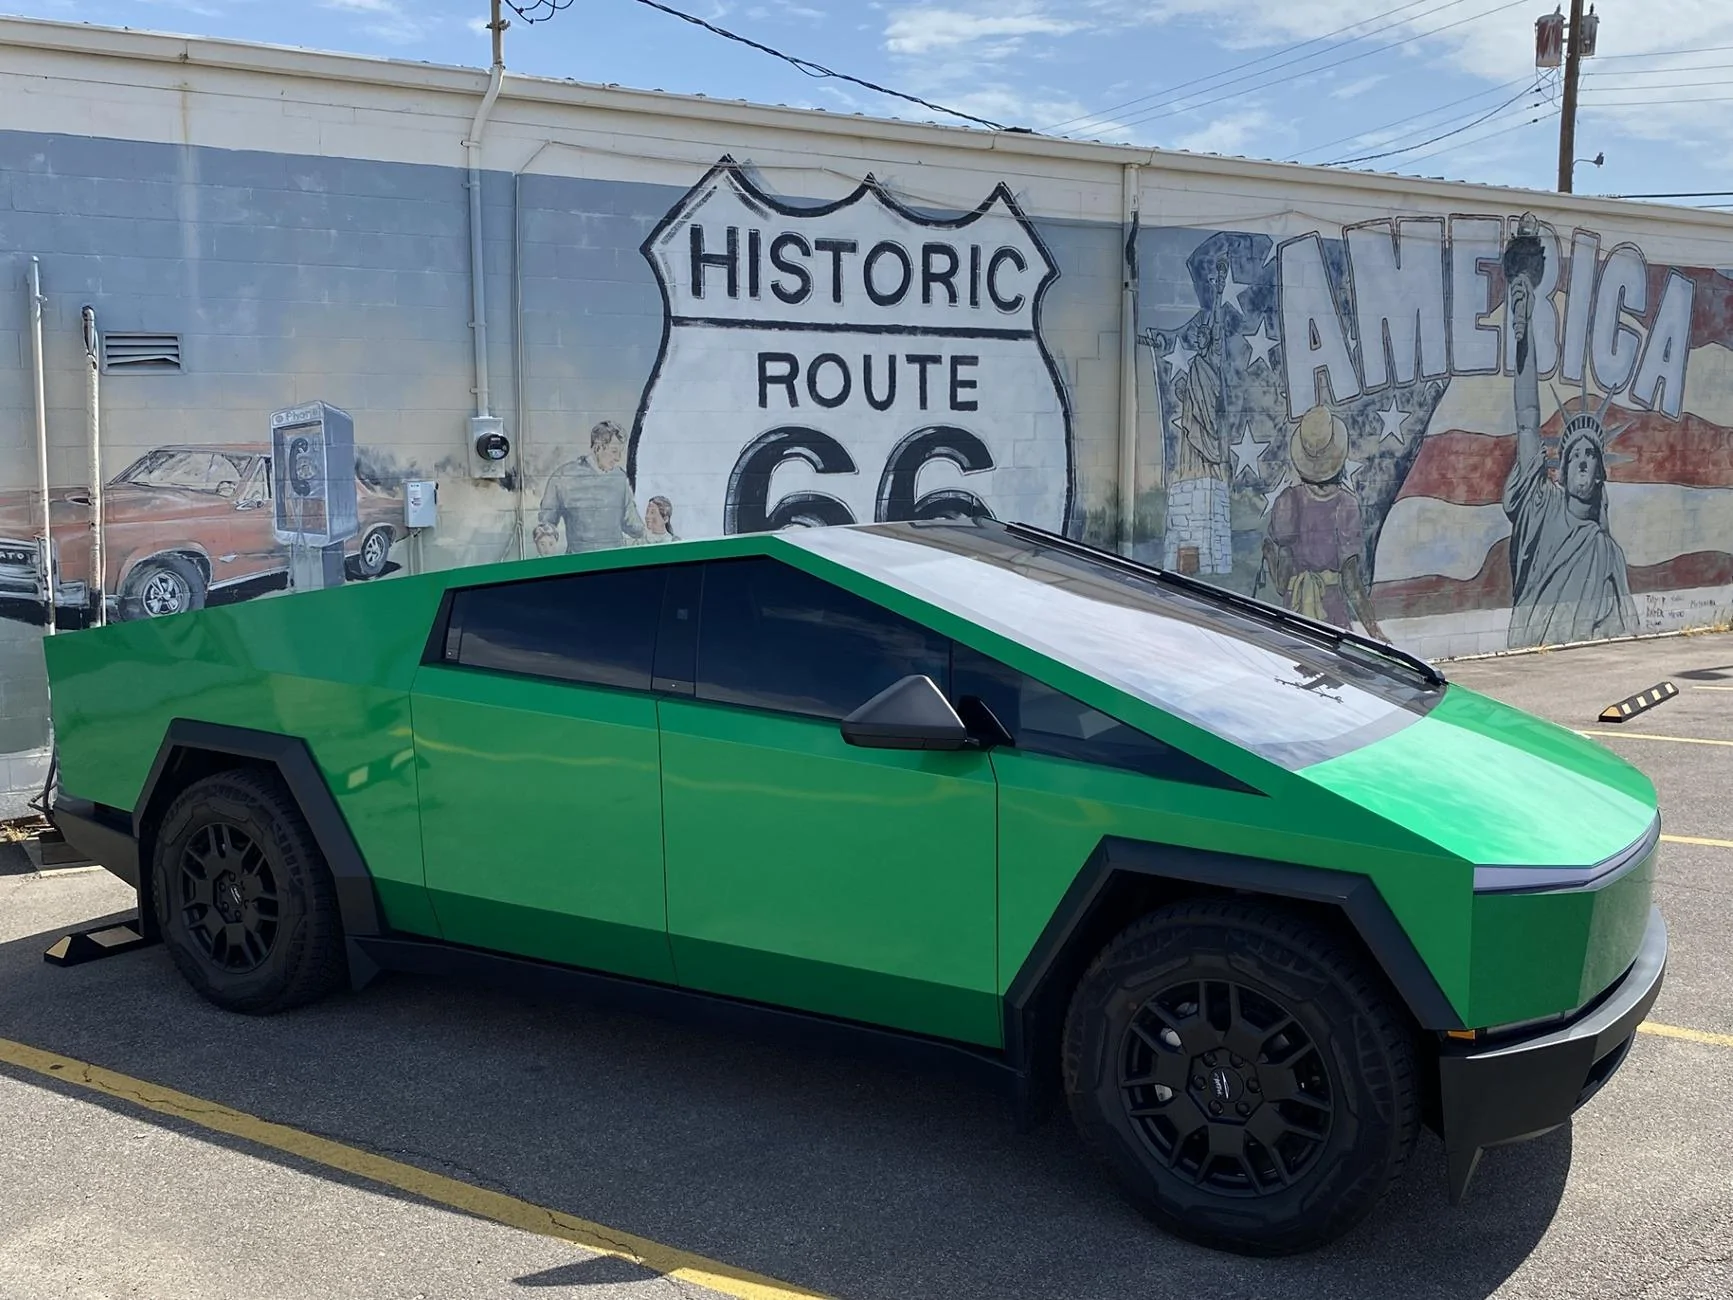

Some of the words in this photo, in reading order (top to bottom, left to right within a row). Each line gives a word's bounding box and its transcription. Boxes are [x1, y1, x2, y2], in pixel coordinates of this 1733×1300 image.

[690, 224, 1028, 315] HISTORIC
[1277, 212, 1698, 424] AMERICA
[757, 351, 980, 412] ROUTE
